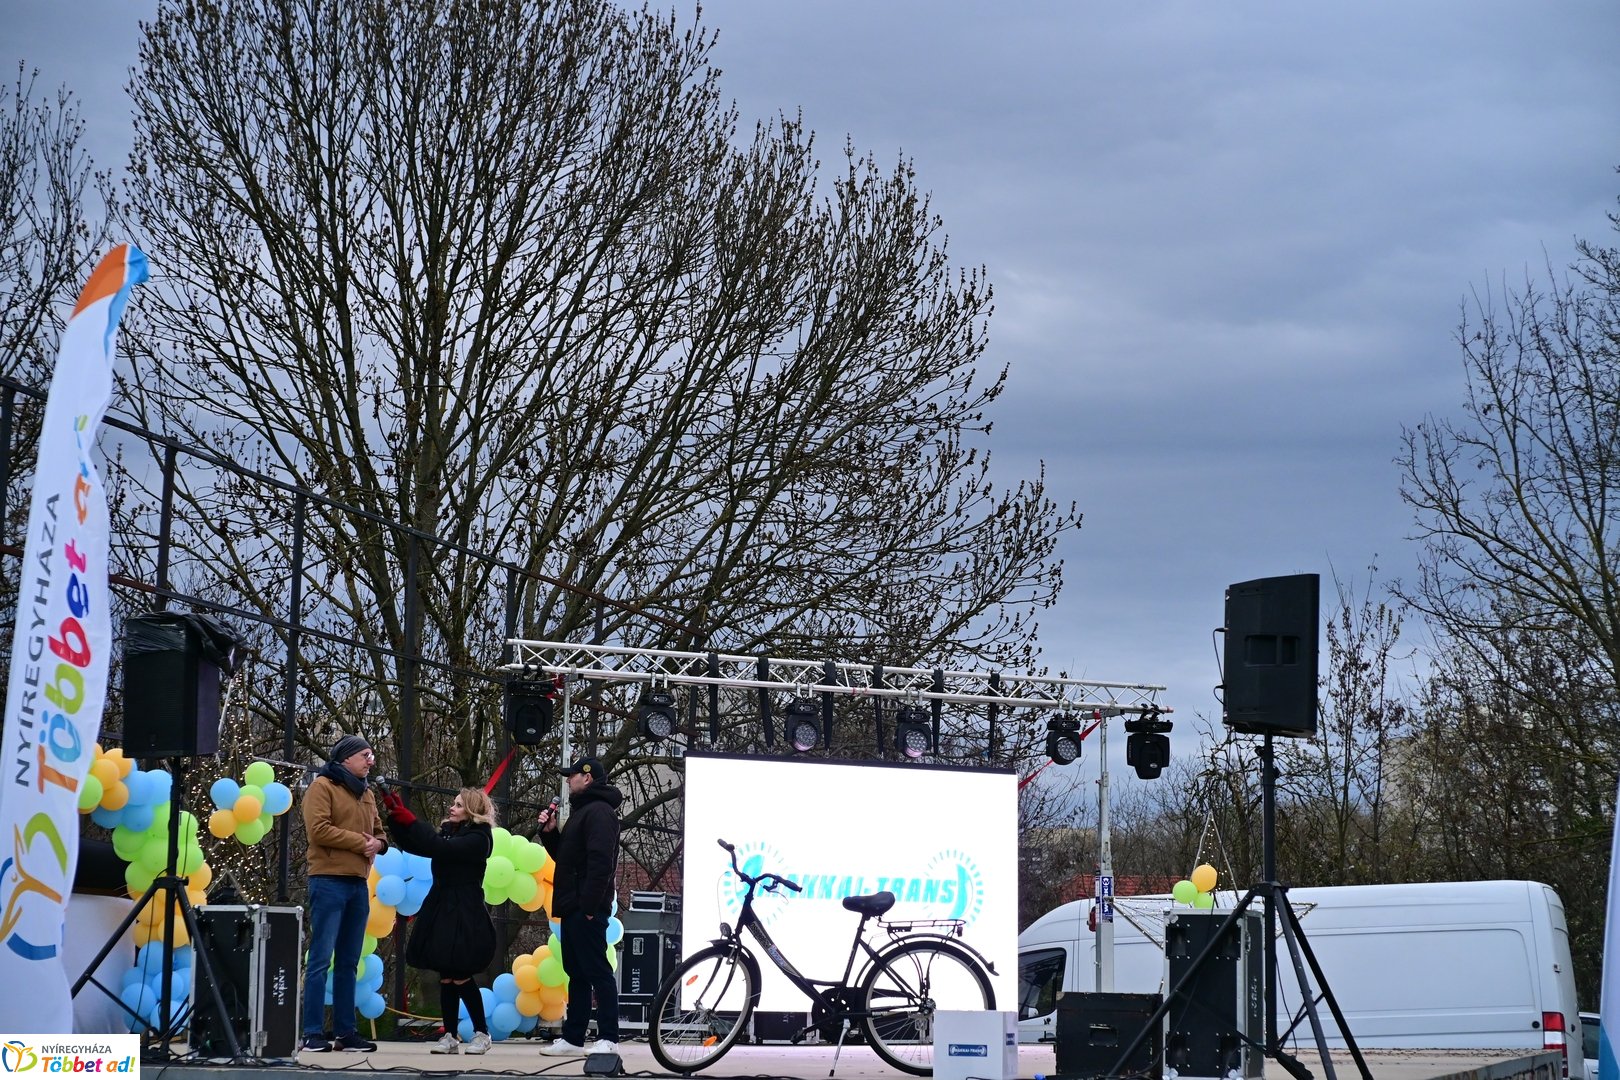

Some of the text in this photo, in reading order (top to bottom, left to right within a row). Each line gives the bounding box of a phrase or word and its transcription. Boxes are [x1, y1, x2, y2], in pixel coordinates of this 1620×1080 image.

[15, 493, 60, 787] NYÍREGYHÁZA
[37, 538, 91, 794] Többet
[278, 966, 286, 1006] EVENT
